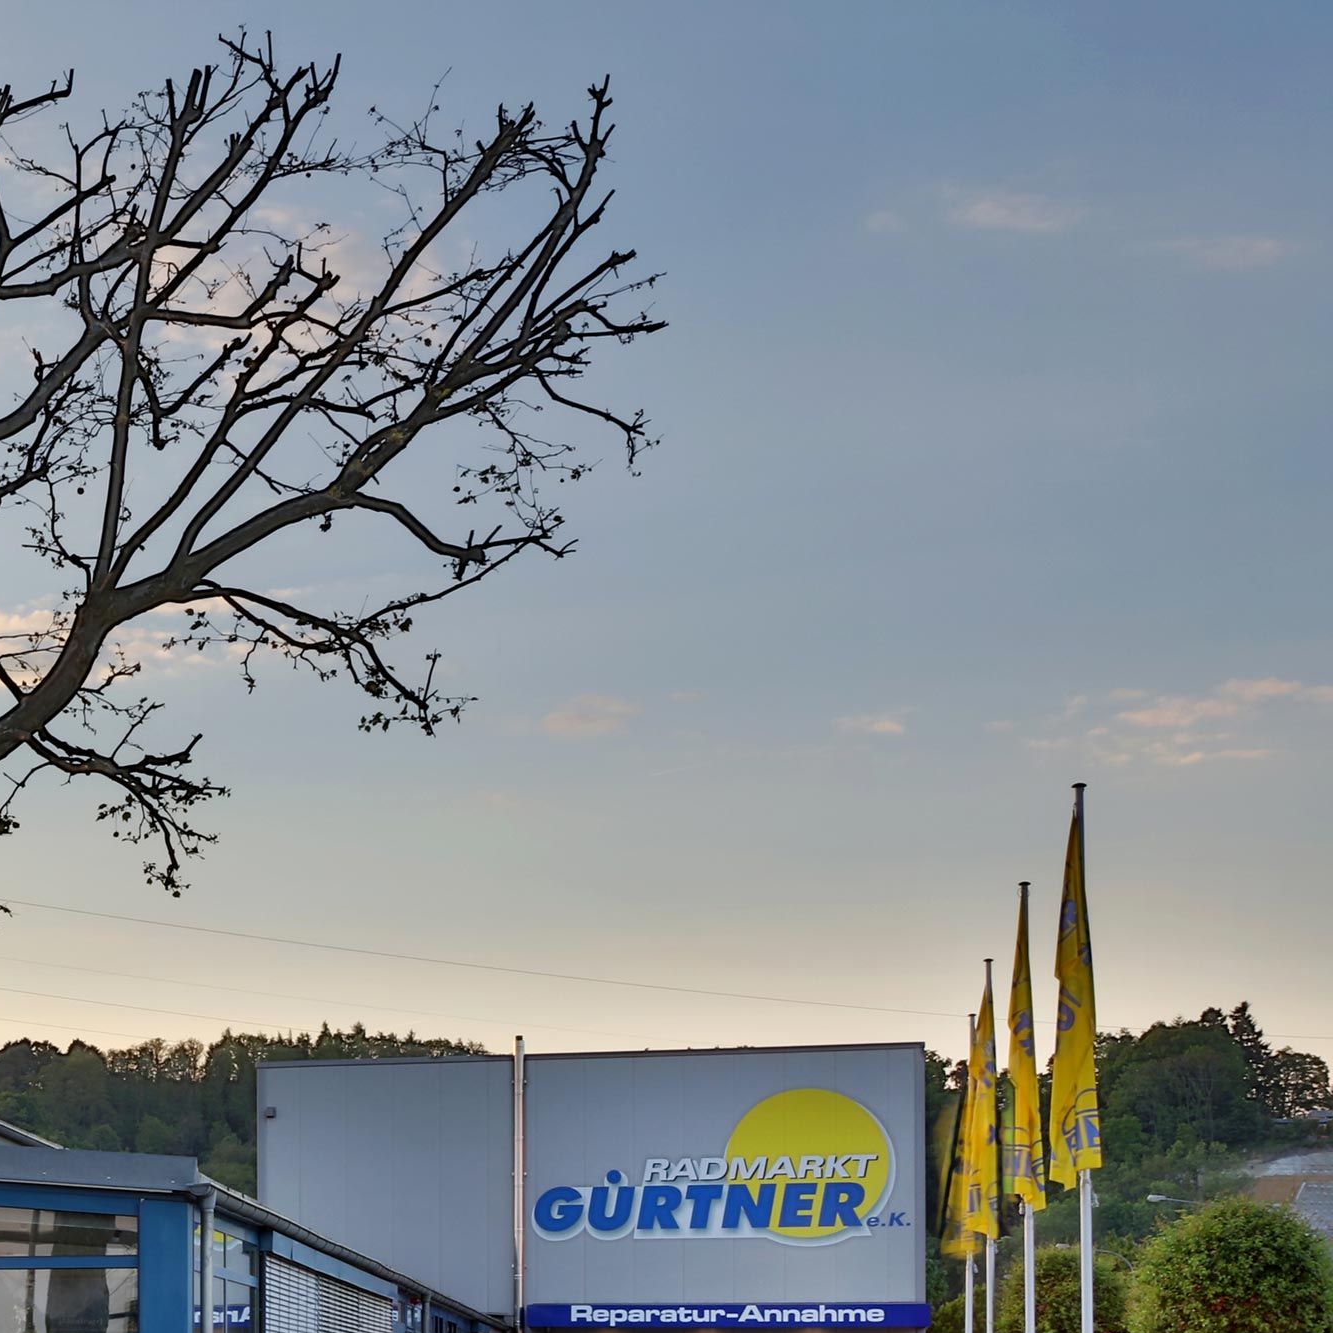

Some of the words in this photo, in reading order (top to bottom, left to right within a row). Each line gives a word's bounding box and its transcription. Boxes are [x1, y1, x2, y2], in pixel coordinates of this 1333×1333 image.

[644, 1154, 879, 1182] RADMARKT
[866, 1211, 912, 1227] e.K.
[570, 1304, 885, 1327] Reparatur-Annahme
